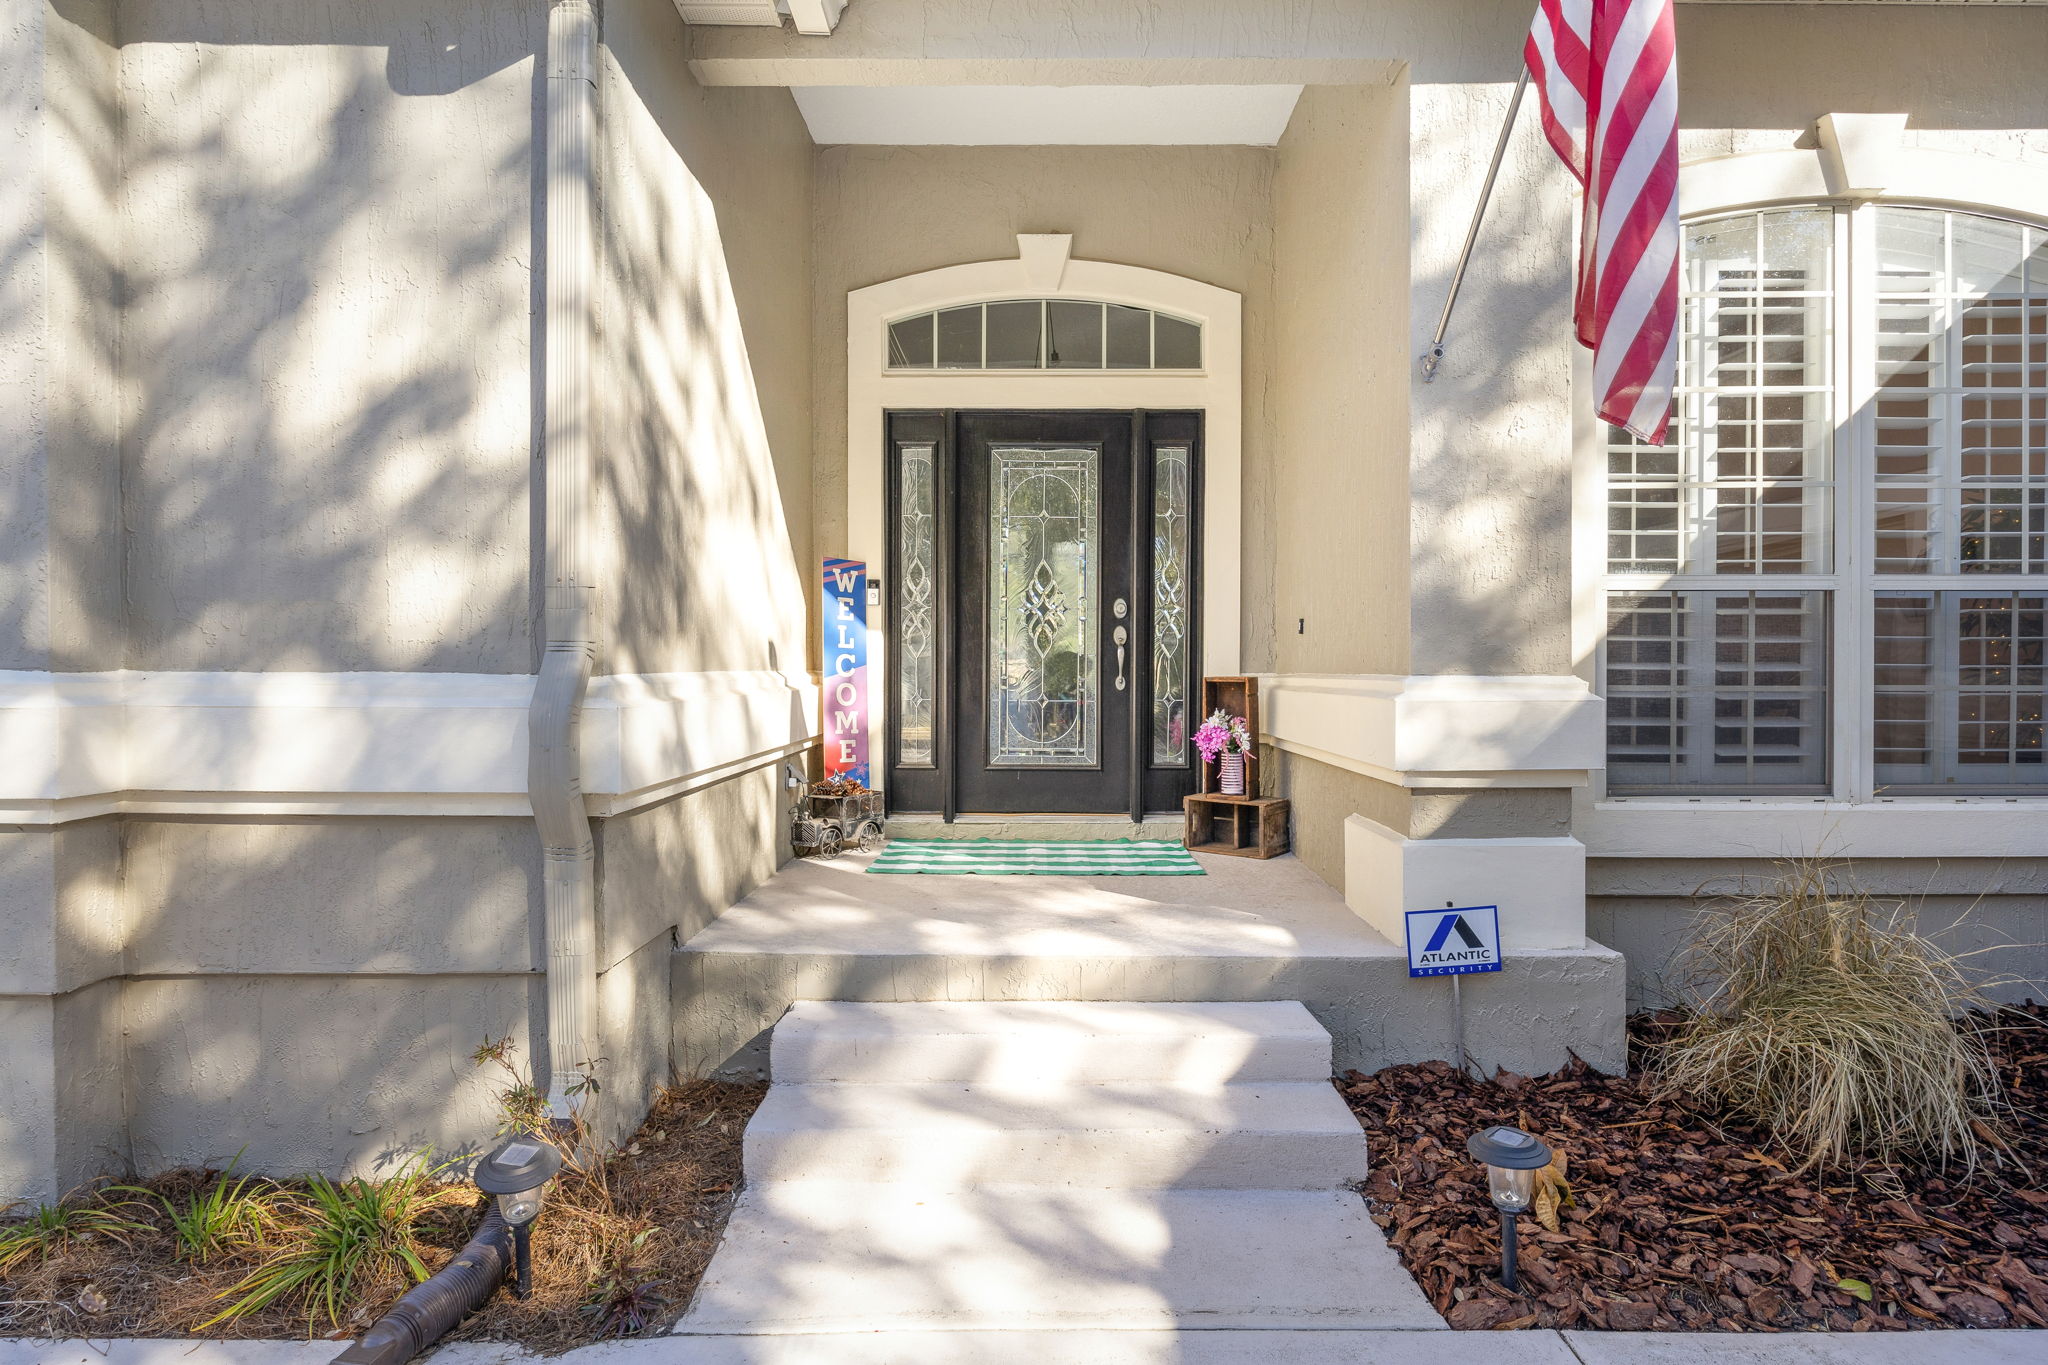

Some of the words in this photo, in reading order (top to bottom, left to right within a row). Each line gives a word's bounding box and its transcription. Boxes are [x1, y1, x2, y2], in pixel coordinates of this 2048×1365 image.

[832, 567, 859, 763] WELCOME
[1420, 950, 1491, 963] ATLANTIC
[1418, 965, 1493, 975] SECURITY
